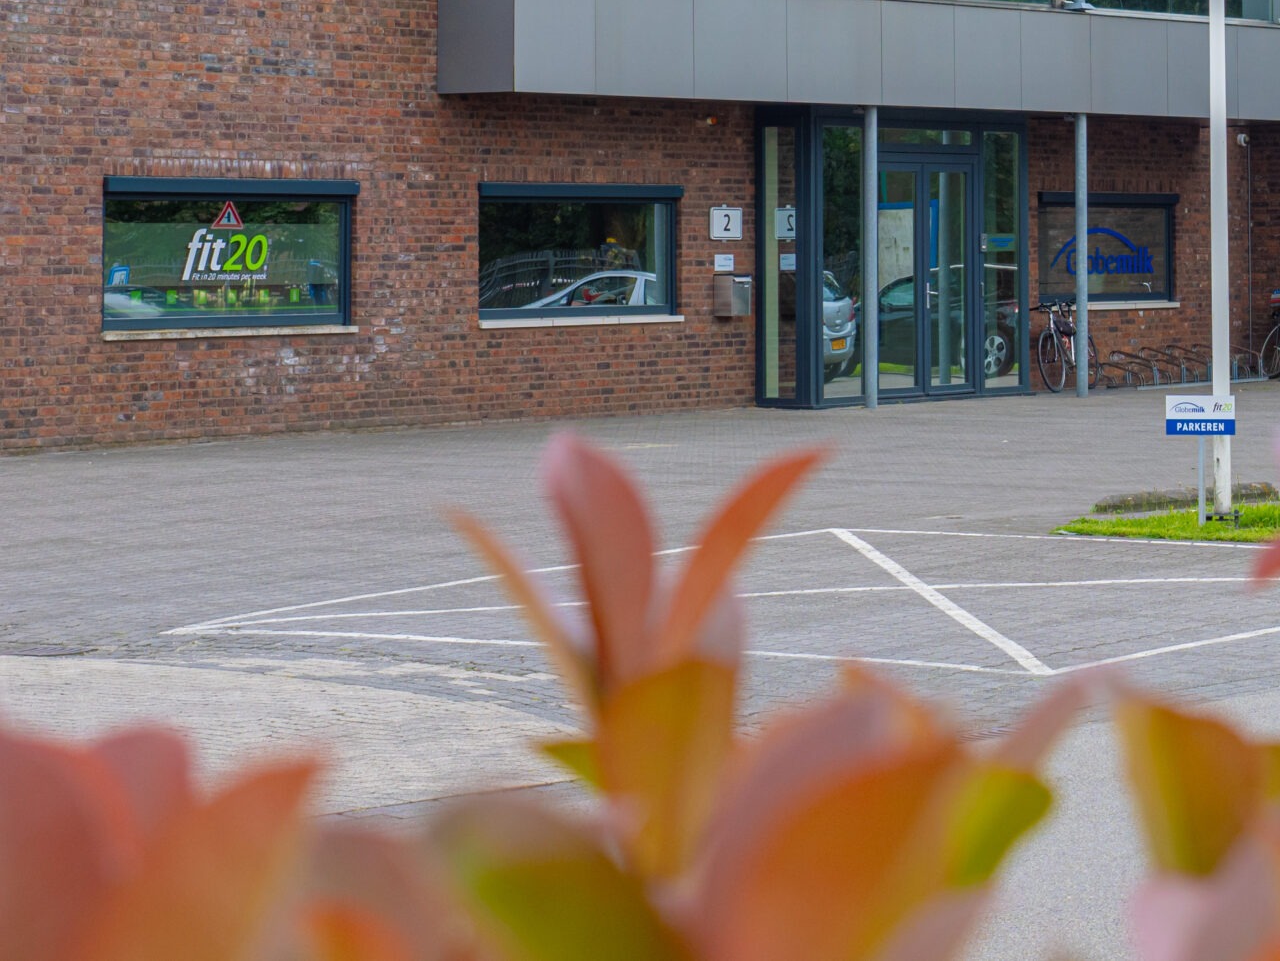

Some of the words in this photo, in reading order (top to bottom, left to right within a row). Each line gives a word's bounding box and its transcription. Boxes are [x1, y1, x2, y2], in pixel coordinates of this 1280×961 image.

[724, 214, 731, 231] 2
[182, 228, 268, 280] fit20
[1066, 247, 1154, 275] Gobemilk
[192, 273, 200, 281] Fit
[1213, 402, 1233, 413] fit20
[1176, 423, 1224, 431] PARKEREN
